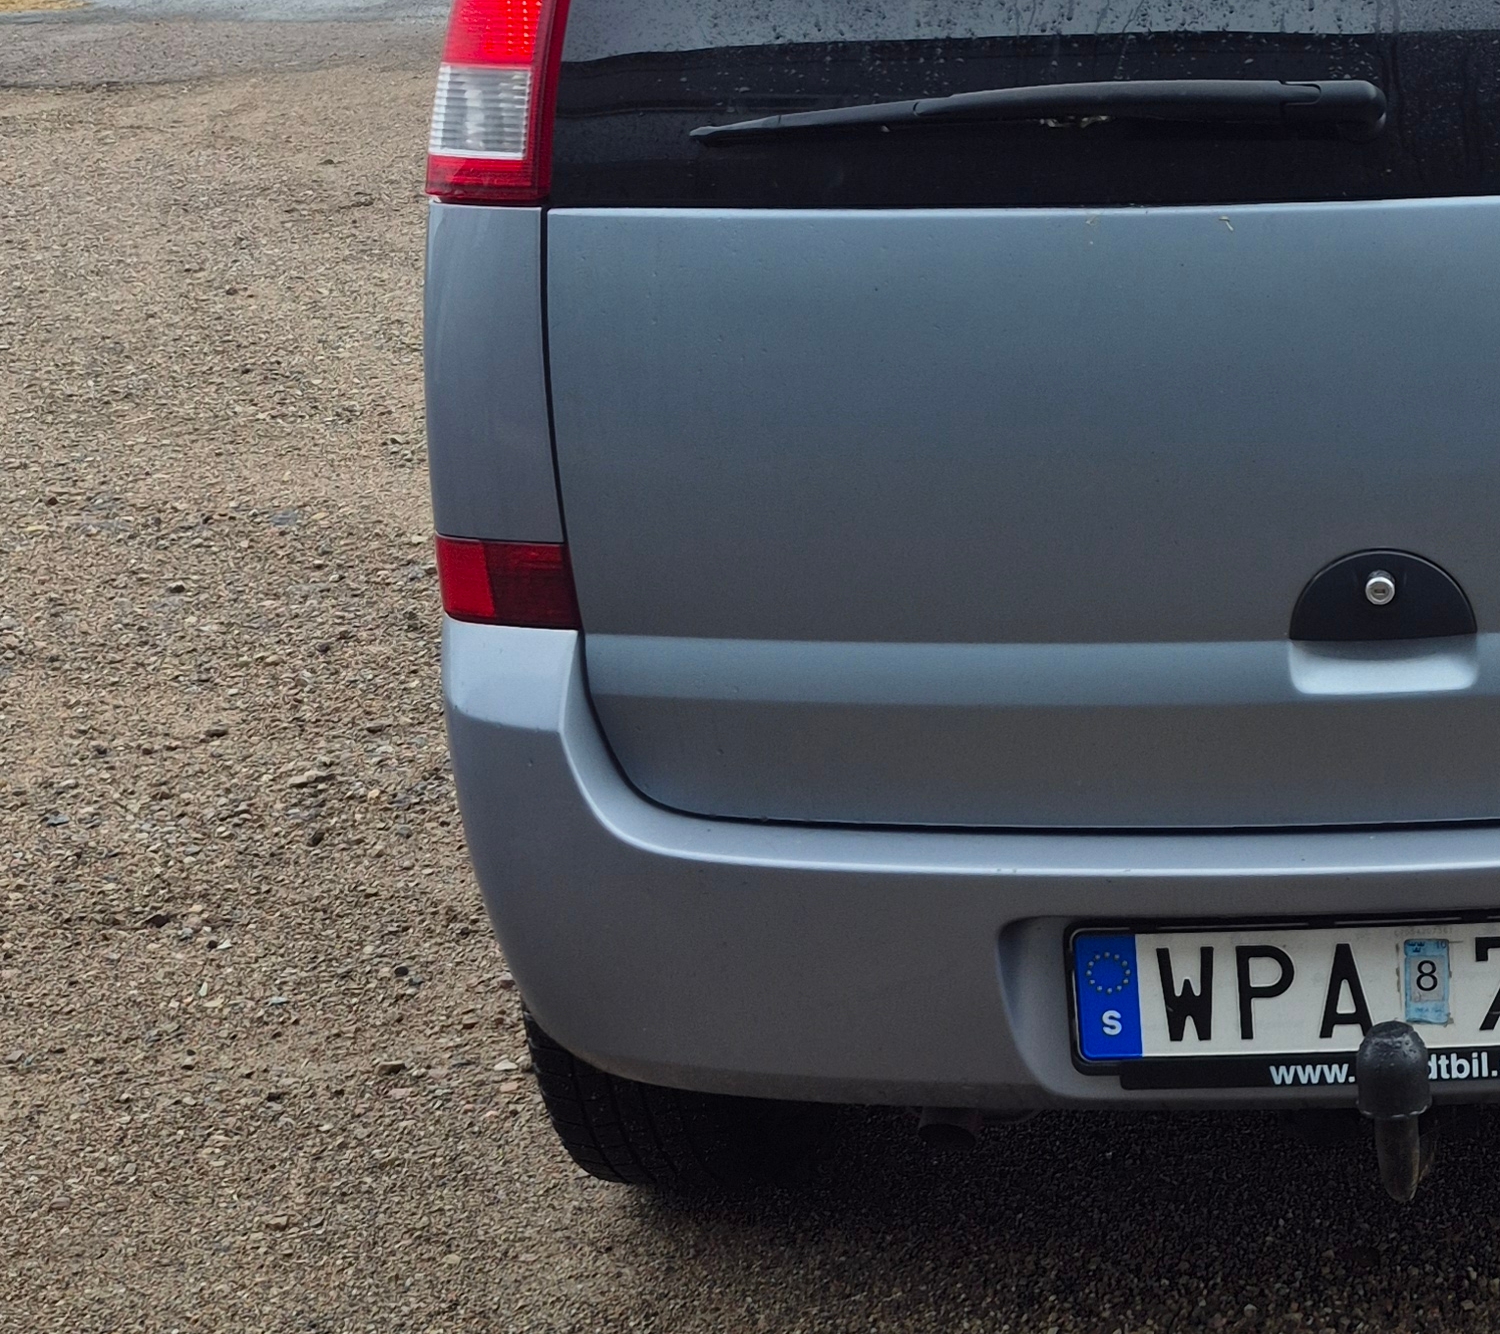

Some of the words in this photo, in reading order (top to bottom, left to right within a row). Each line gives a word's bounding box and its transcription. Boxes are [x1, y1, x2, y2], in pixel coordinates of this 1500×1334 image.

[1155, 942, 1374, 1042] WPA
[1416, 959, 1438, 992] 8
[1101, 1009, 1123, 1037] S
